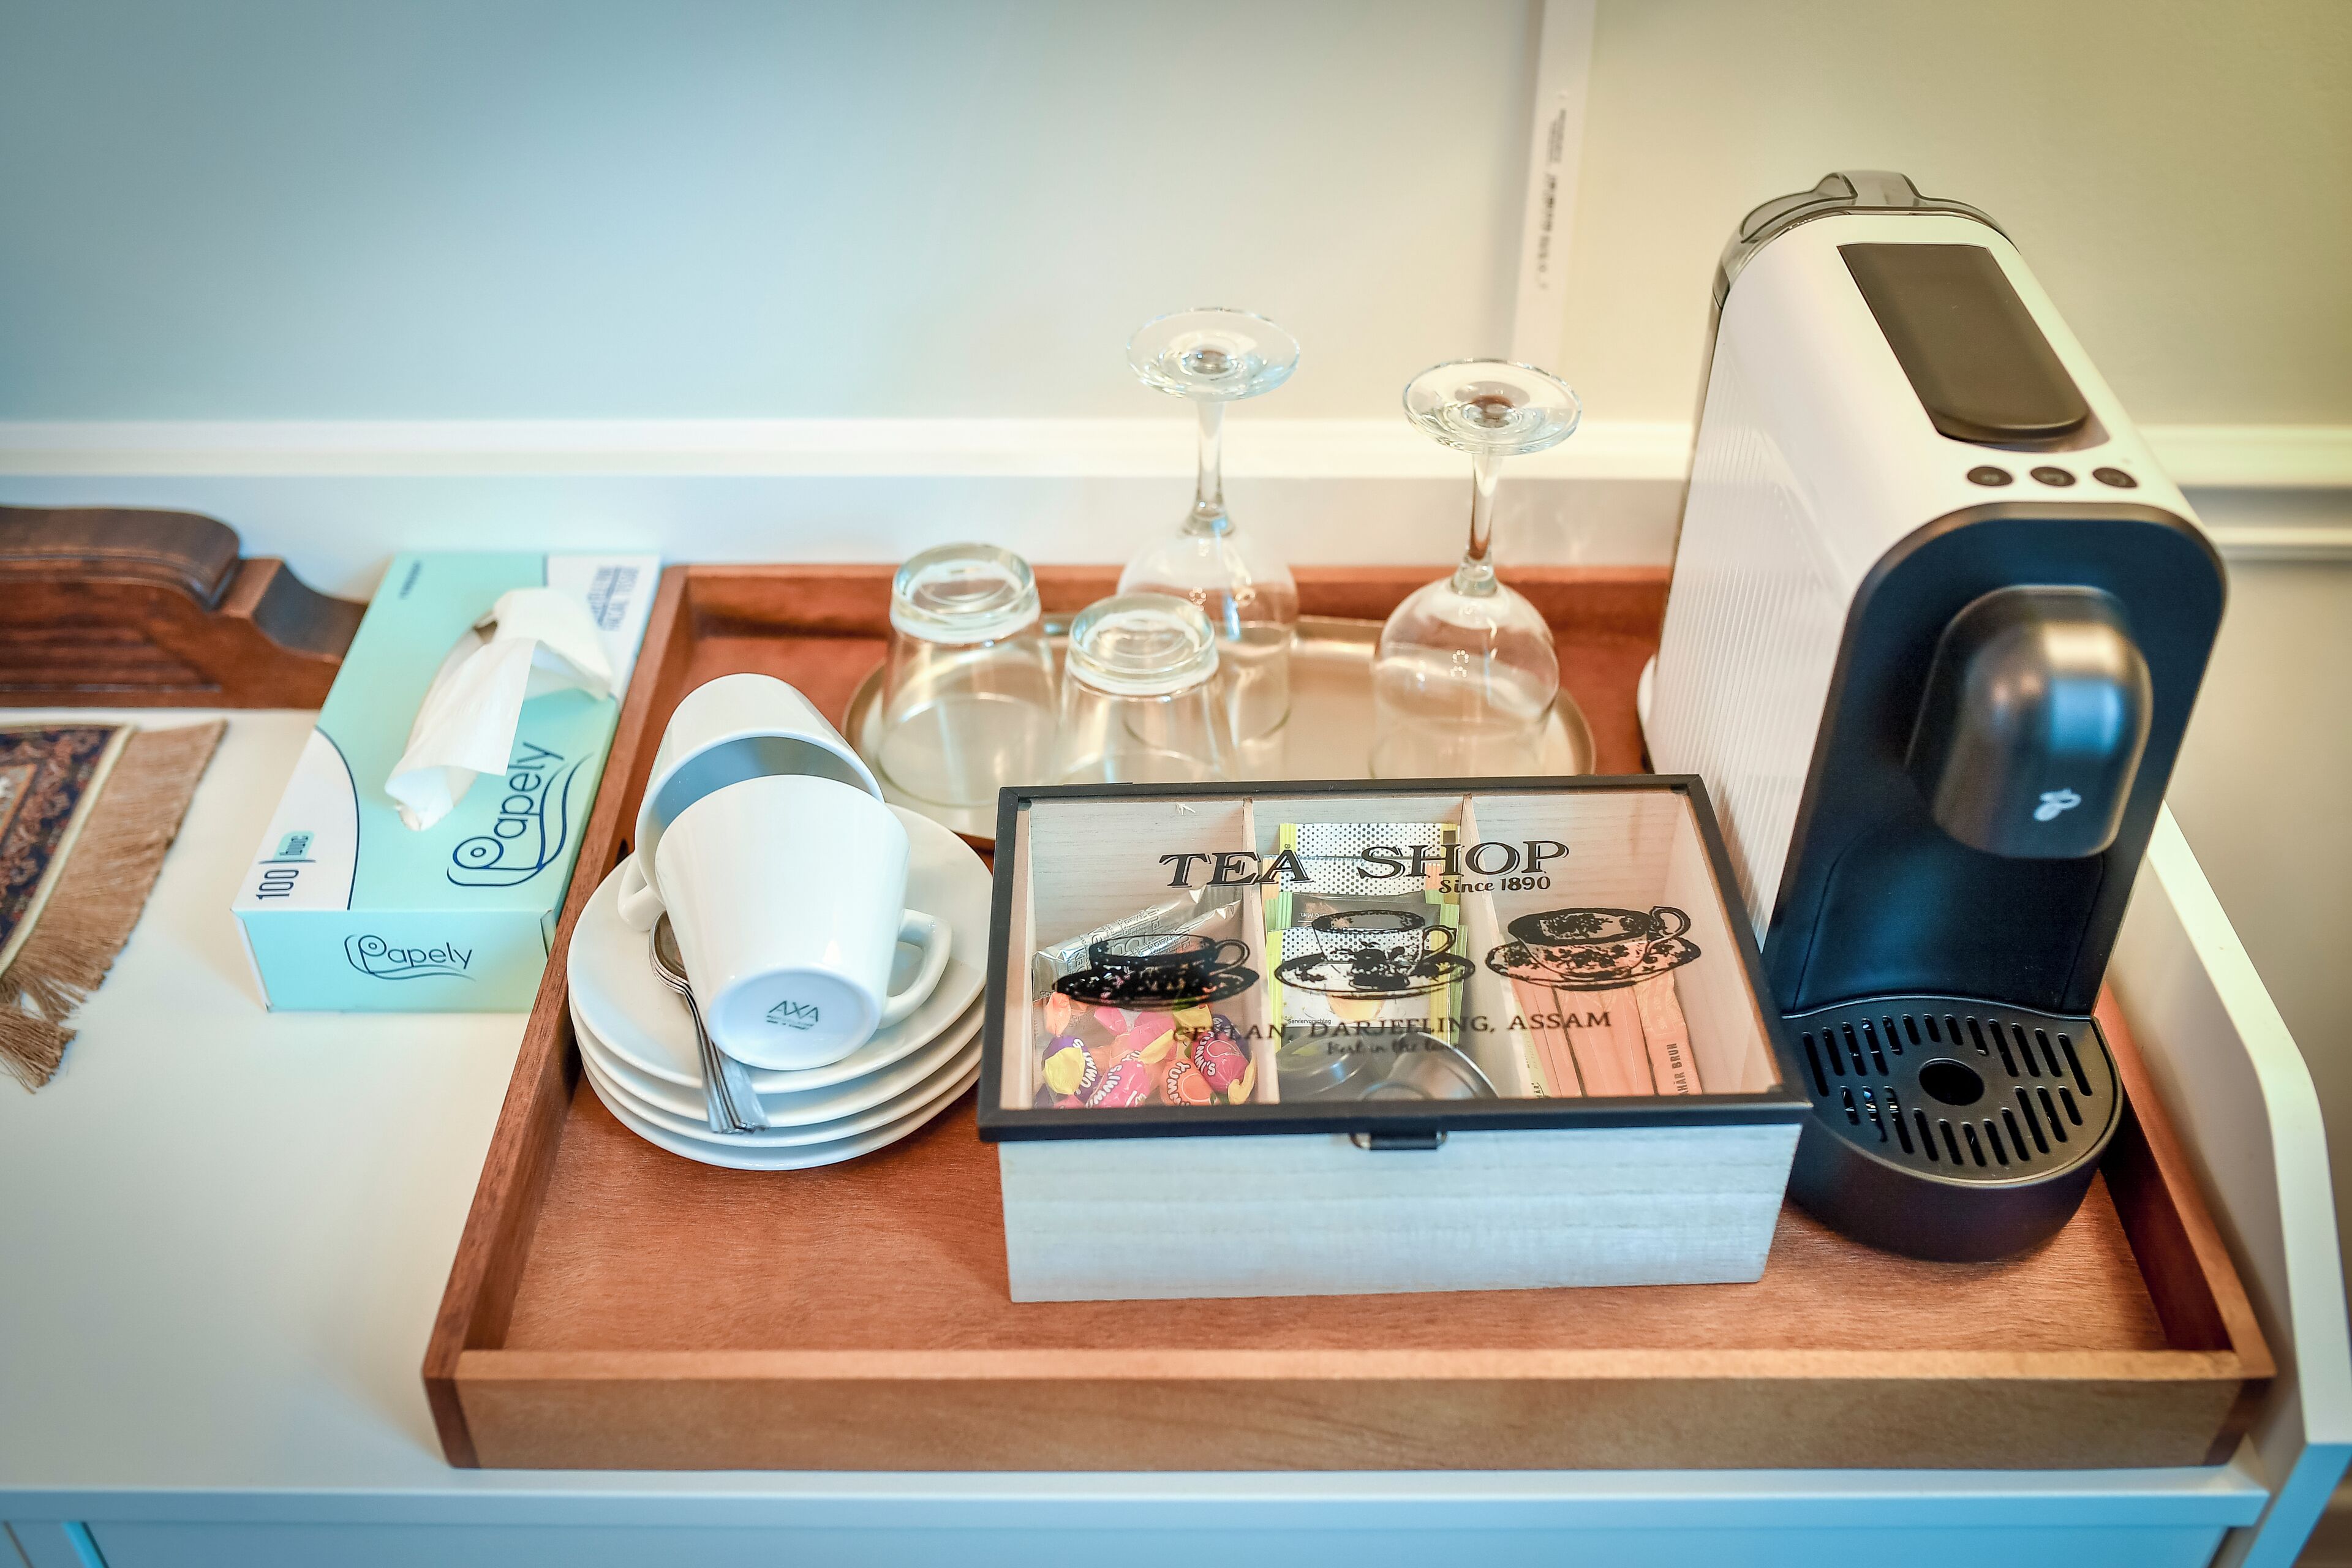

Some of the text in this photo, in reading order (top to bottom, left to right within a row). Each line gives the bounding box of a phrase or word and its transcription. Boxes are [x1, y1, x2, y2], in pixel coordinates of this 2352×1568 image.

[450, 741, 566, 876] Papely
[1159, 840, 1569, 888] TEA SHOP
[256, 869, 300, 901] 100
[1439, 876, 1551, 893] Since 1890
[350, 935, 473, 976] Papely
[769, 1000, 819, 1022] AXA
[1507, 1011, 1612, 1030] ASSAM
[1667, 1042, 1683, 1070] BRUN
